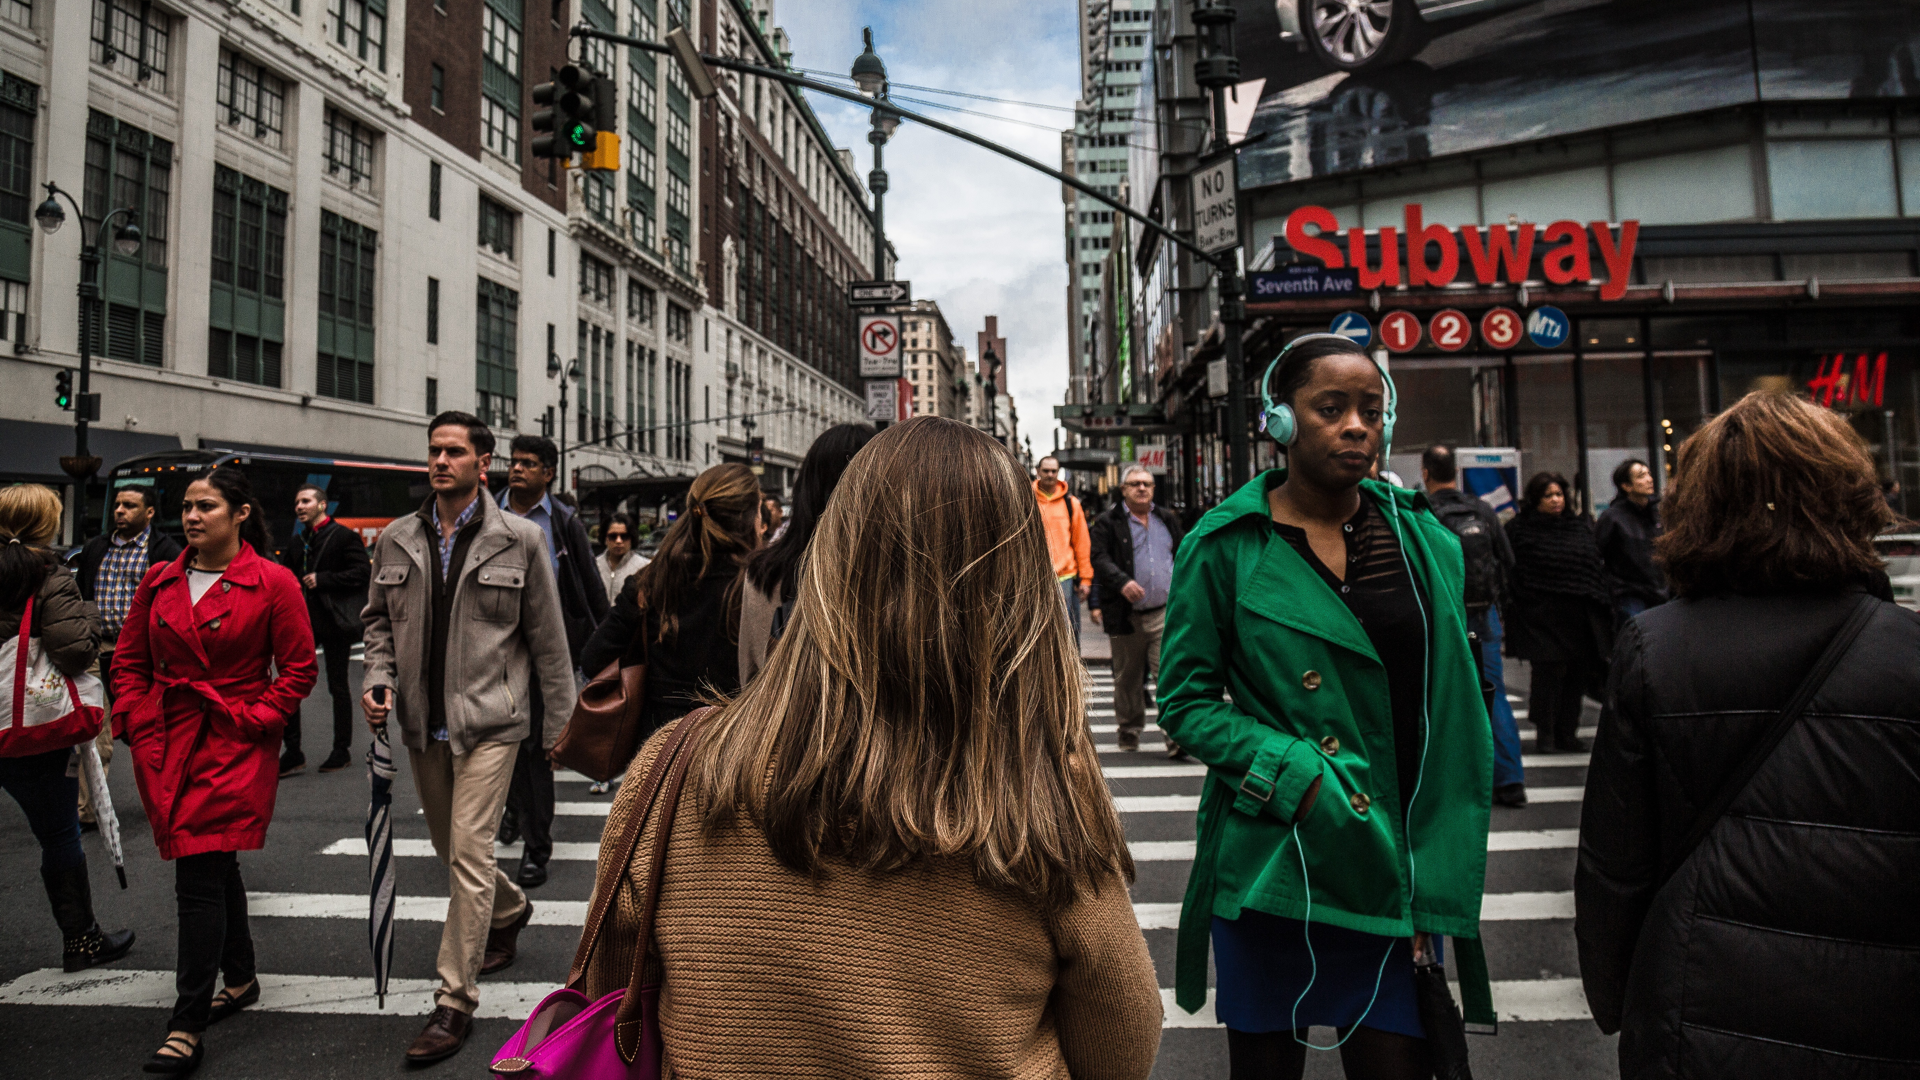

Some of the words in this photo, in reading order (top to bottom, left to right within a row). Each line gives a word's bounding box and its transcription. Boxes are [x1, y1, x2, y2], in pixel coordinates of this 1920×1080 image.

[1202, 170, 1225, 199] NO
[1195, 198, 1236, 229] TURNS
[1284, 203, 1640, 301] Subway
[1255, 275, 1319, 294] Seventh
[1322, 275, 1353, 292] Ave
[1391, 318, 1408, 345] 1
[1440, 317, 1462, 344] 2
[1491, 313, 1514, 343] 3
[1529, 310, 1561, 338] MTA
[1807, 351, 1888, 408] H&M
